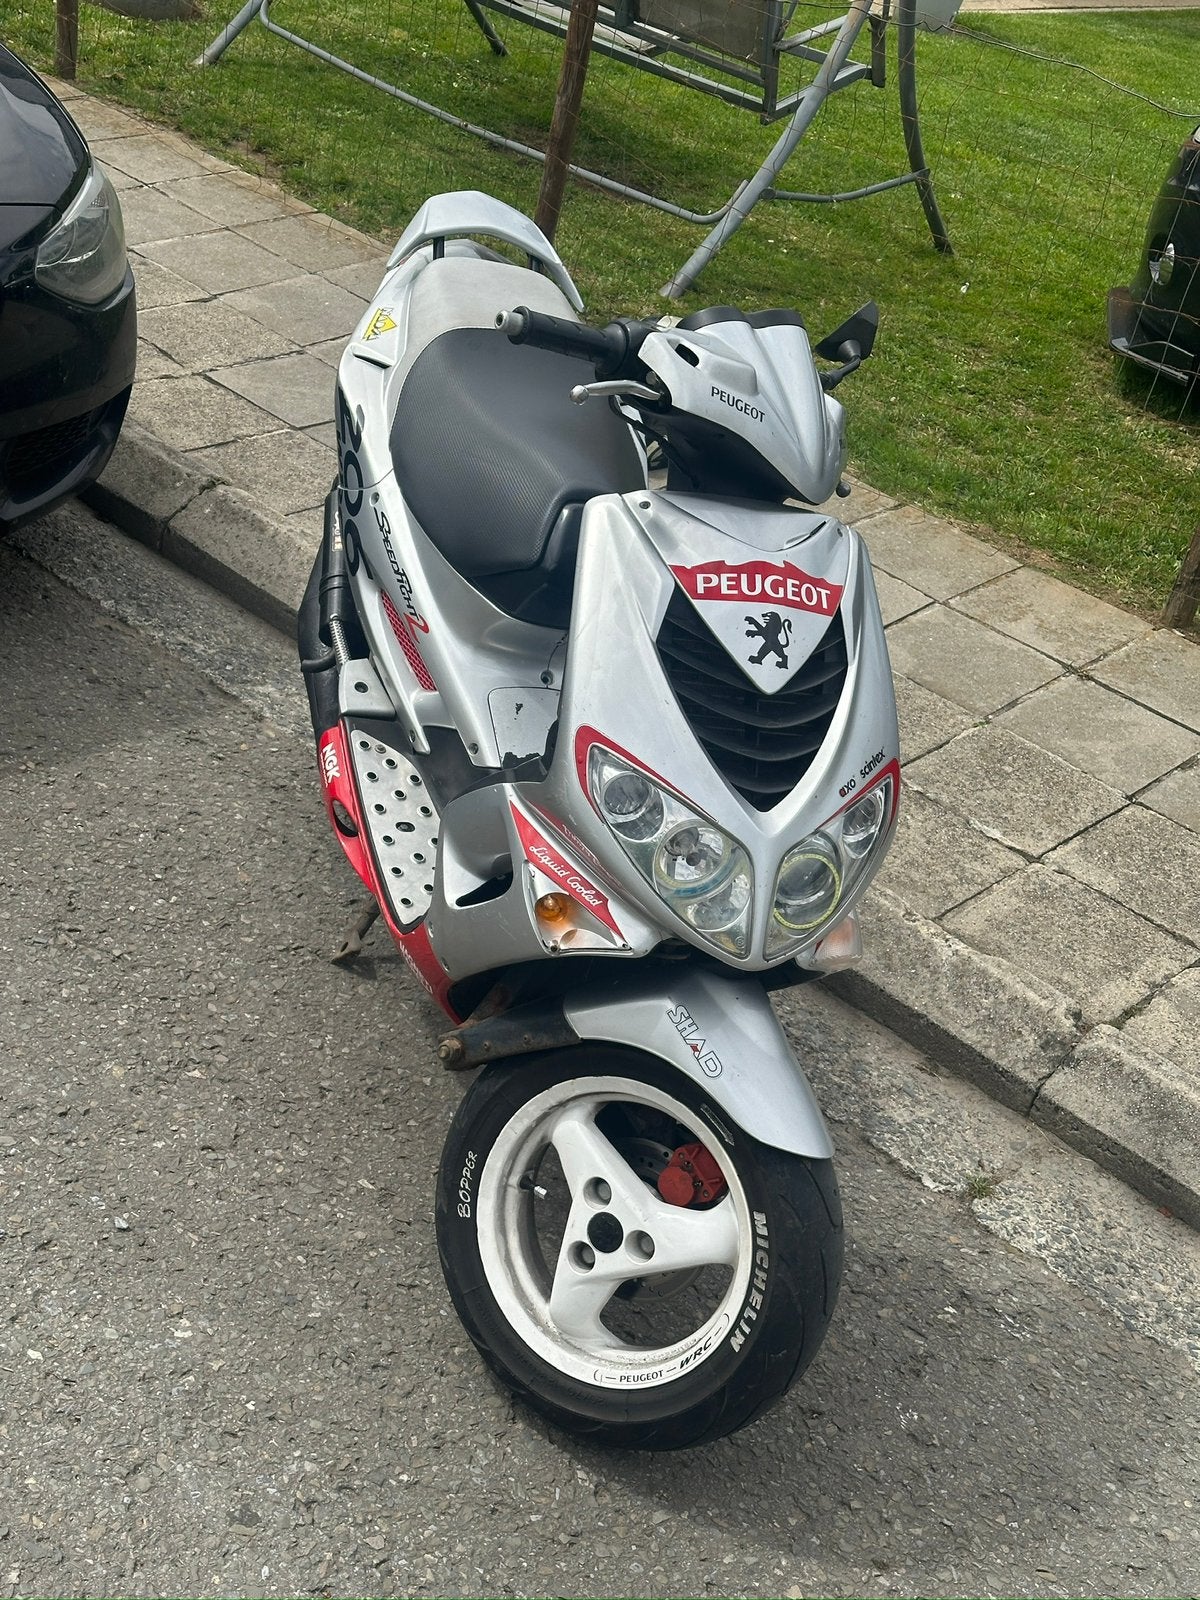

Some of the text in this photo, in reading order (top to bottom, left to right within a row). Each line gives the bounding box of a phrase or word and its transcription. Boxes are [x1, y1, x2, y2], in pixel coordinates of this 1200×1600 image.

[711, 385, 766, 423] PEUGEOT
[338, 386, 373, 581] 206
[695, 572, 831, 610] PEUGEOT
[322, 741, 340, 787] NGK
[859, 748, 886, 779] scintex
[529, 845, 569, 878] Liquid
[566, 876, 603, 907] Cooled
[666, 1004, 723, 1078] SHAD
[457, 1150, 478, 1218] BOPPER
[729, 1210, 770, 1353] MICHELIN
[619, 1369, 664, 1384] PEUGEOT
[679, 1336, 712, 1370] WRC
